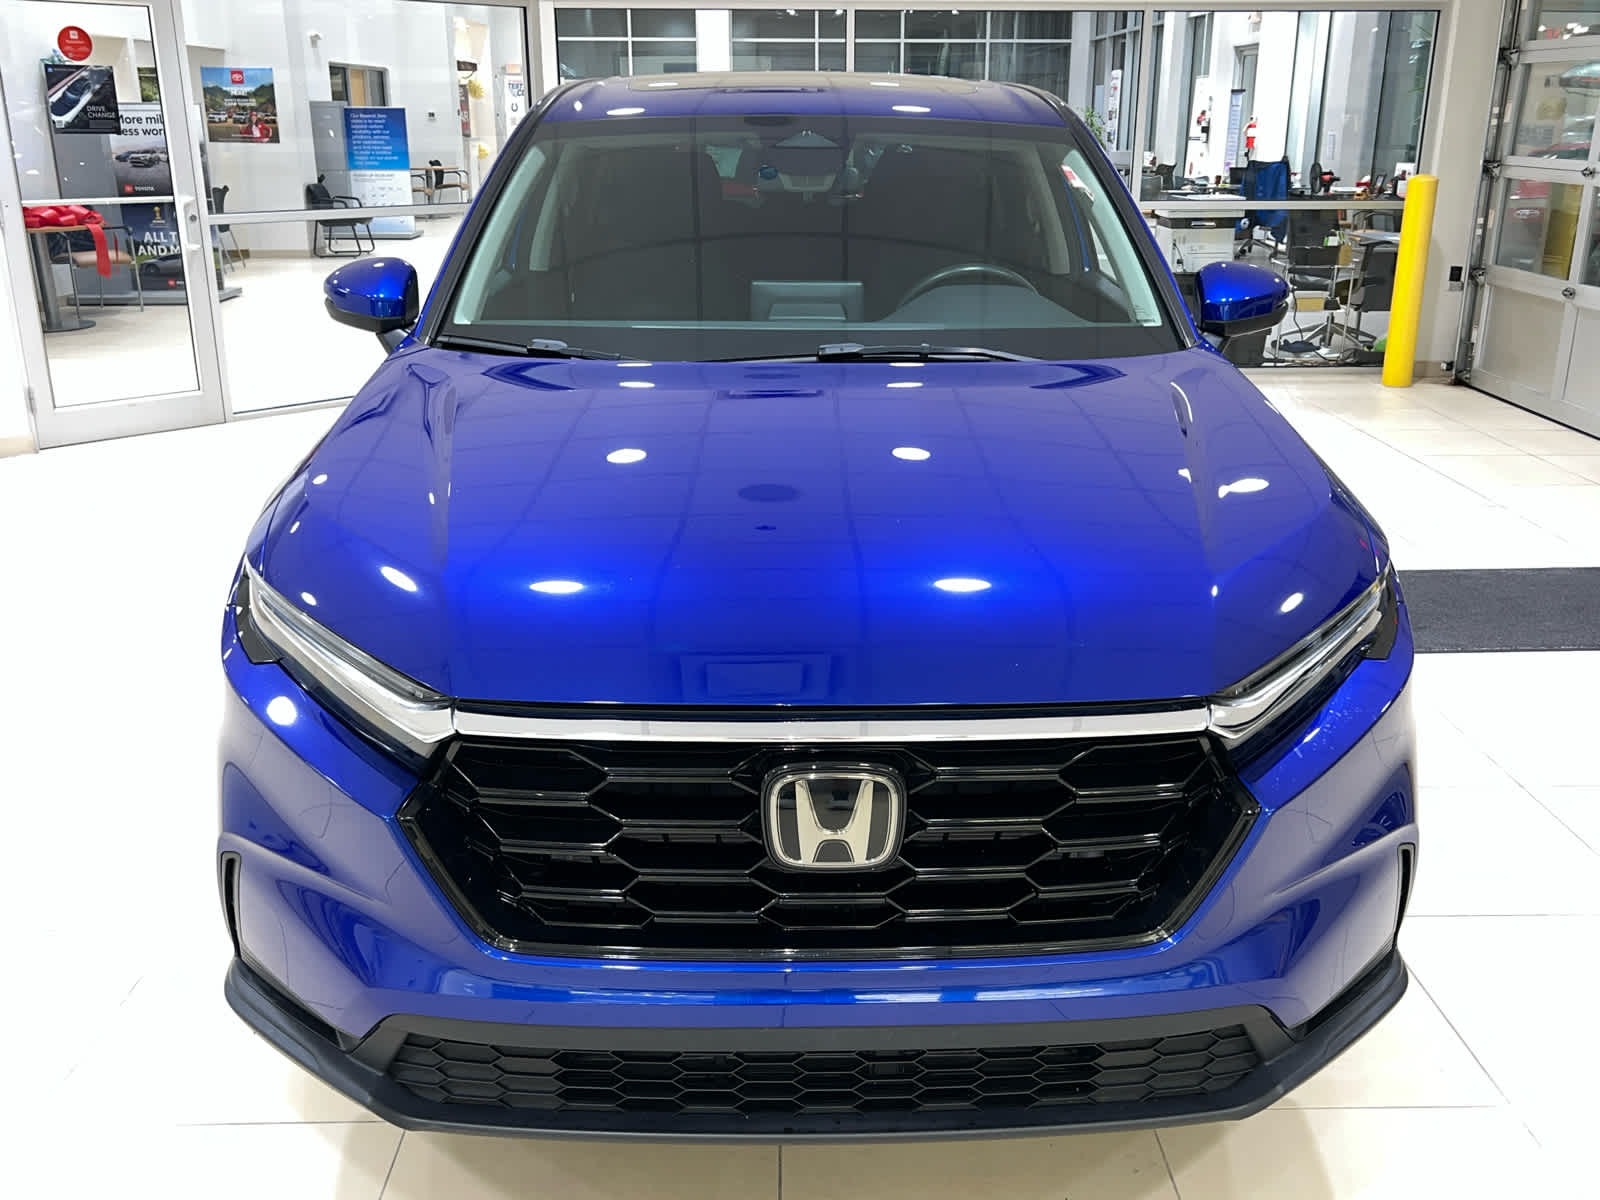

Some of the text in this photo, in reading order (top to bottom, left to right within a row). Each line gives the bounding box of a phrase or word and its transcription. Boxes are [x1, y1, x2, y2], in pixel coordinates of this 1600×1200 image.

[87, 111, 115, 119] CHANGE
[144, 231, 168, 243] ALL
[138, 245, 167, 256] AND
